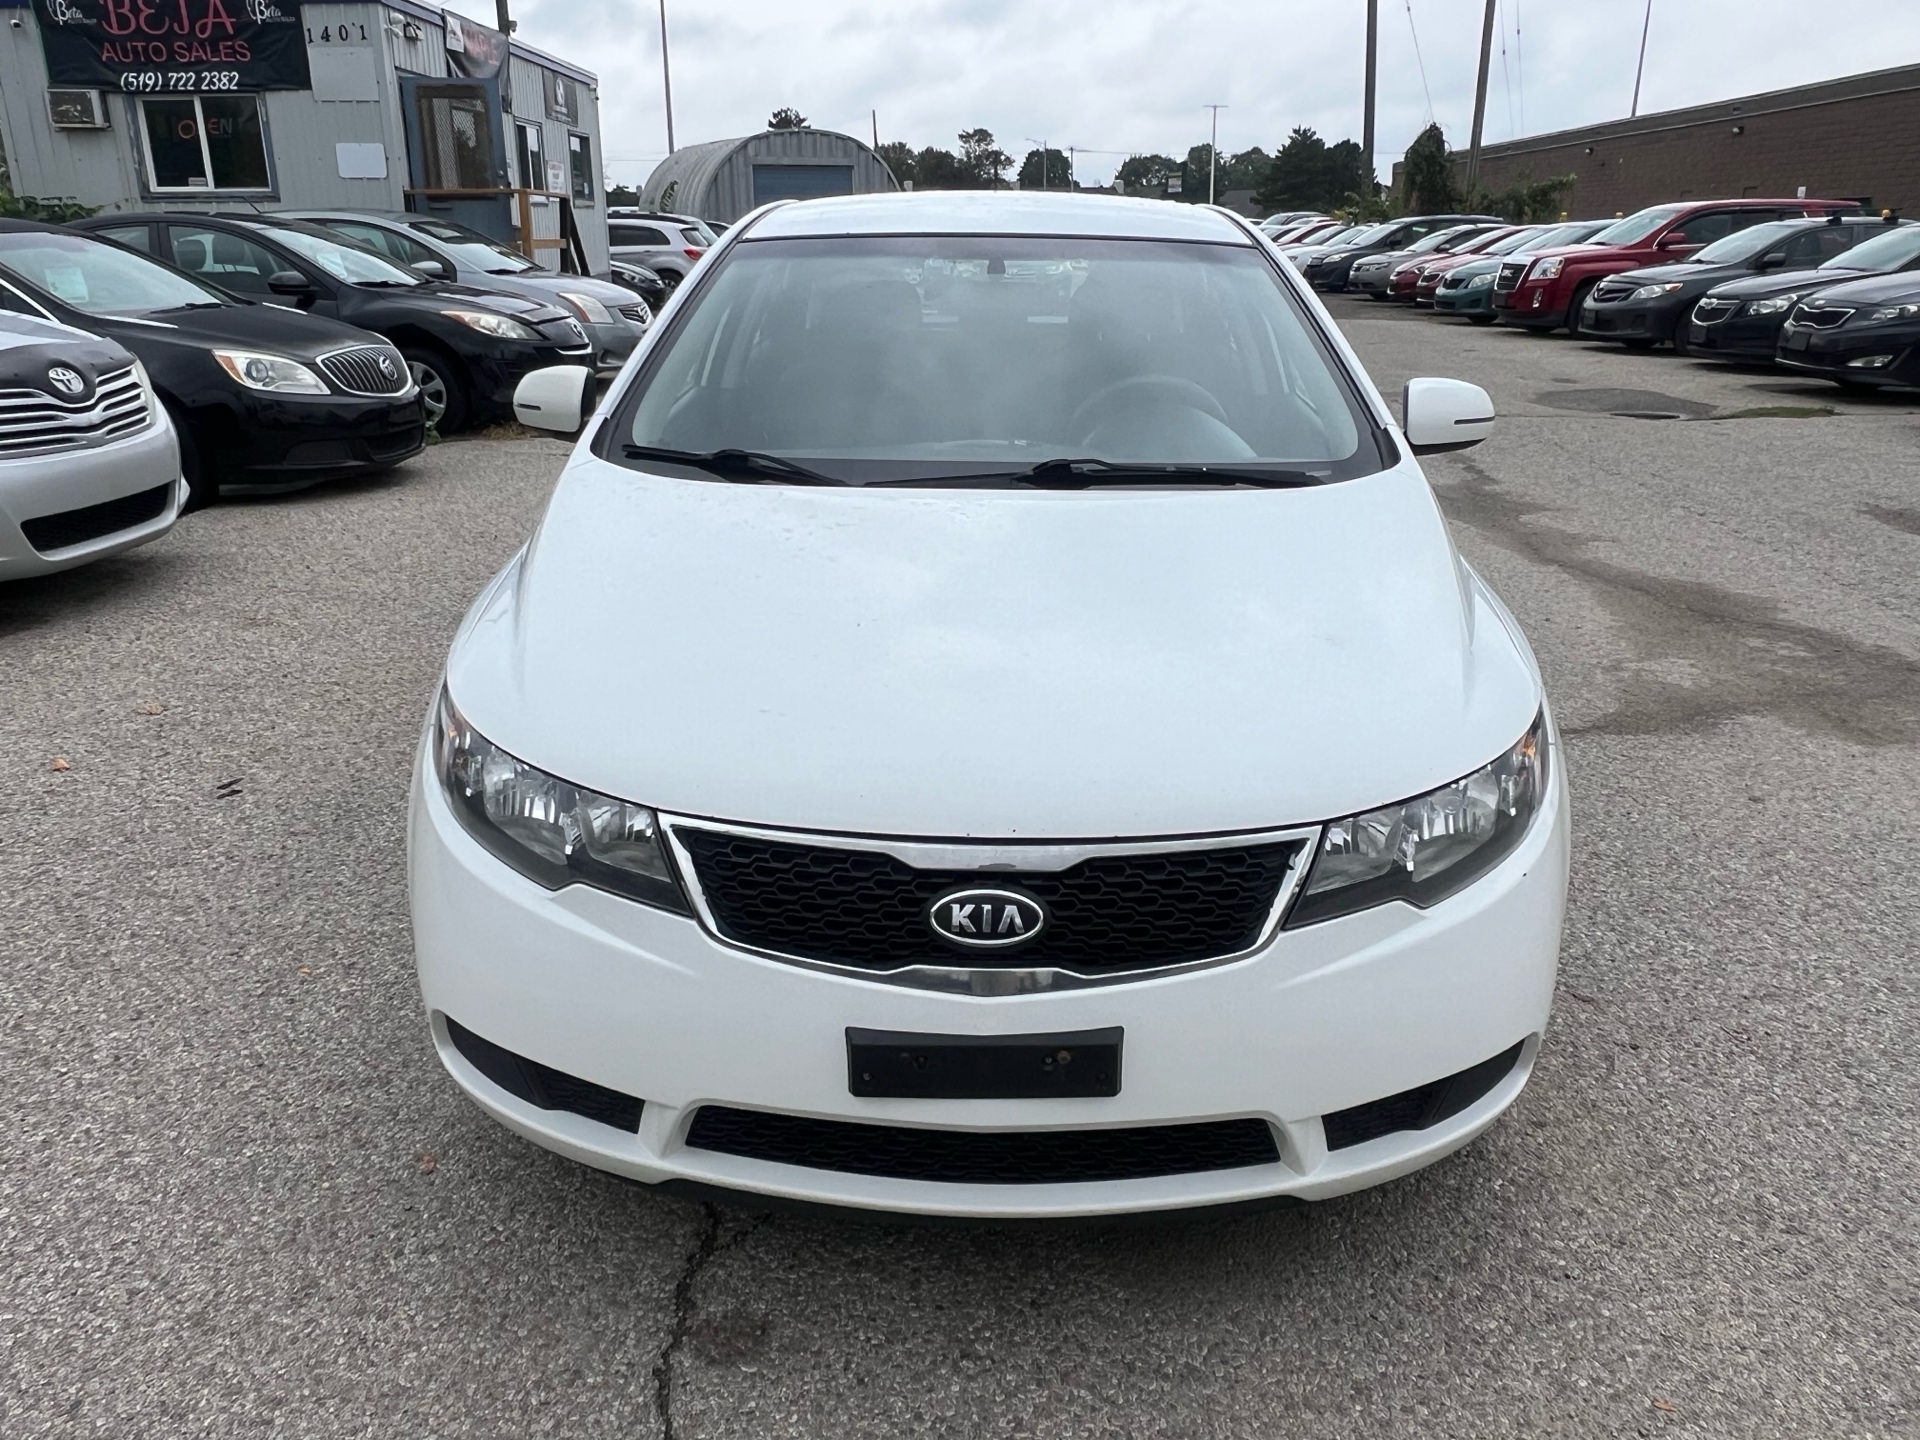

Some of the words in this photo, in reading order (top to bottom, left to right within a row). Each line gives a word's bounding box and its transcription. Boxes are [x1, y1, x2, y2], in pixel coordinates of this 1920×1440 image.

[307, 24, 368, 44] 1401
[102, 41, 168, 62] AUTO
[173, 41, 251, 62] SALES
[120, 72, 163, 92] (519)
[168, 72, 196, 91] 722
[201, 71, 239, 90] 2382
[178, 118, 233, 139] OEN
[950, 903, 1025, 934] KIA
